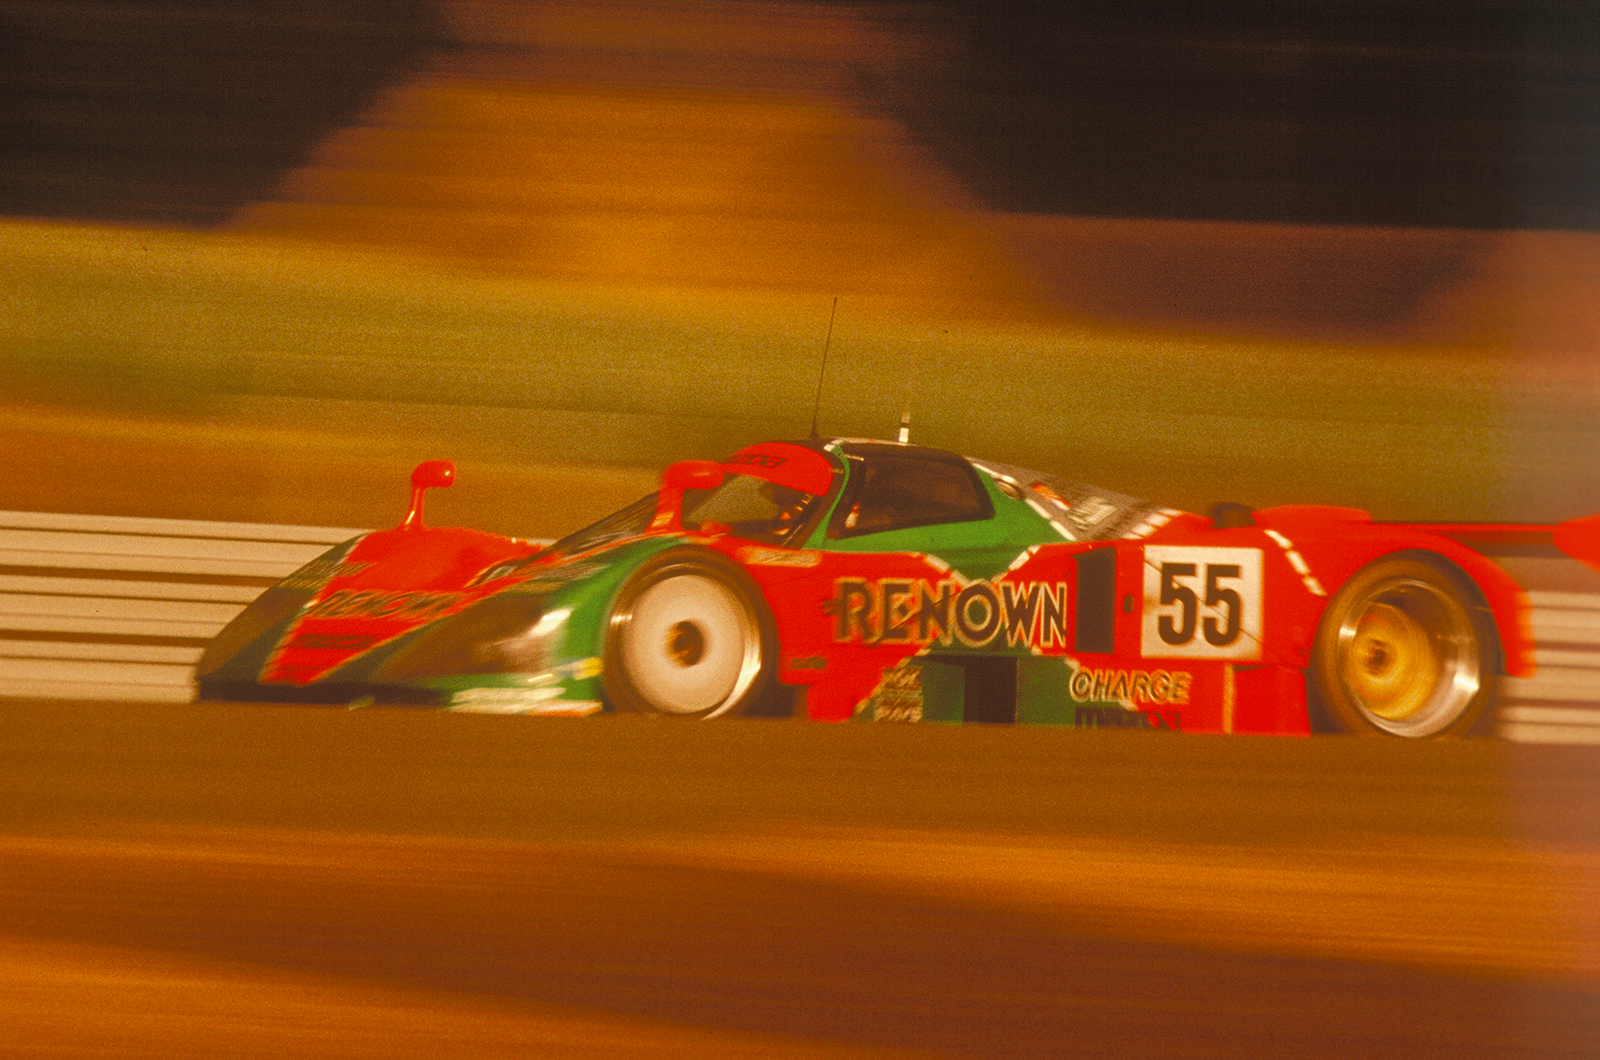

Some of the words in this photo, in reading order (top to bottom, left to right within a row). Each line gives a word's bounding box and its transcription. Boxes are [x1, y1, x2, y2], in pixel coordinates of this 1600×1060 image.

[835, 577, 1068, 647] RENOWN
[1158, 562, 1242, 646] 55
[1069, 666, 1193, 705] CHARGE
